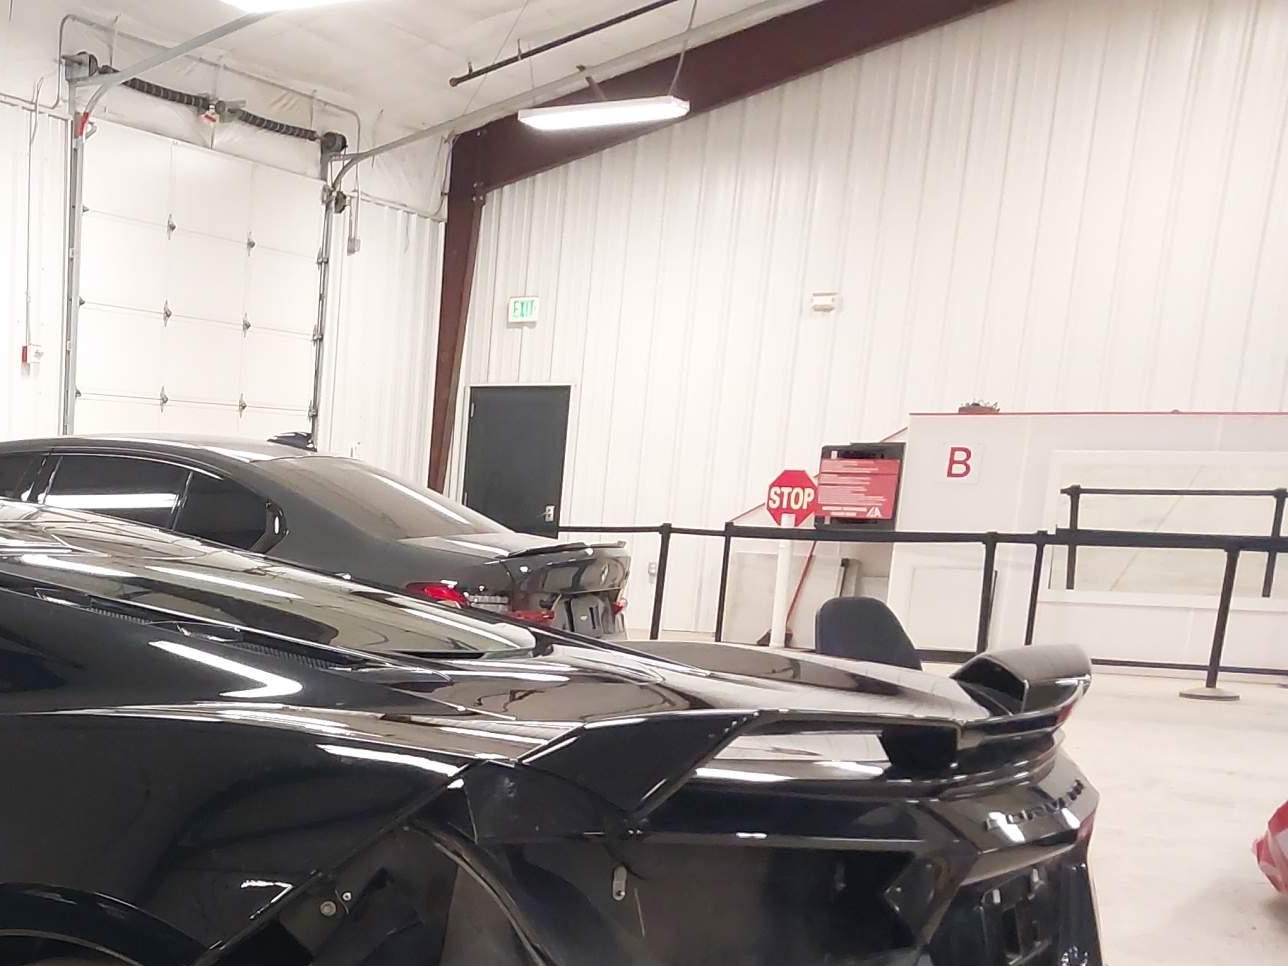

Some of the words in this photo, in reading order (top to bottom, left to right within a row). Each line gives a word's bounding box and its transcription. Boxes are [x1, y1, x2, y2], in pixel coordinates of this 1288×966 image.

[513, 299, 536, 318] EXIT
[946, 446, 972, 478] B
[768, 486, 815, 510] STOP
